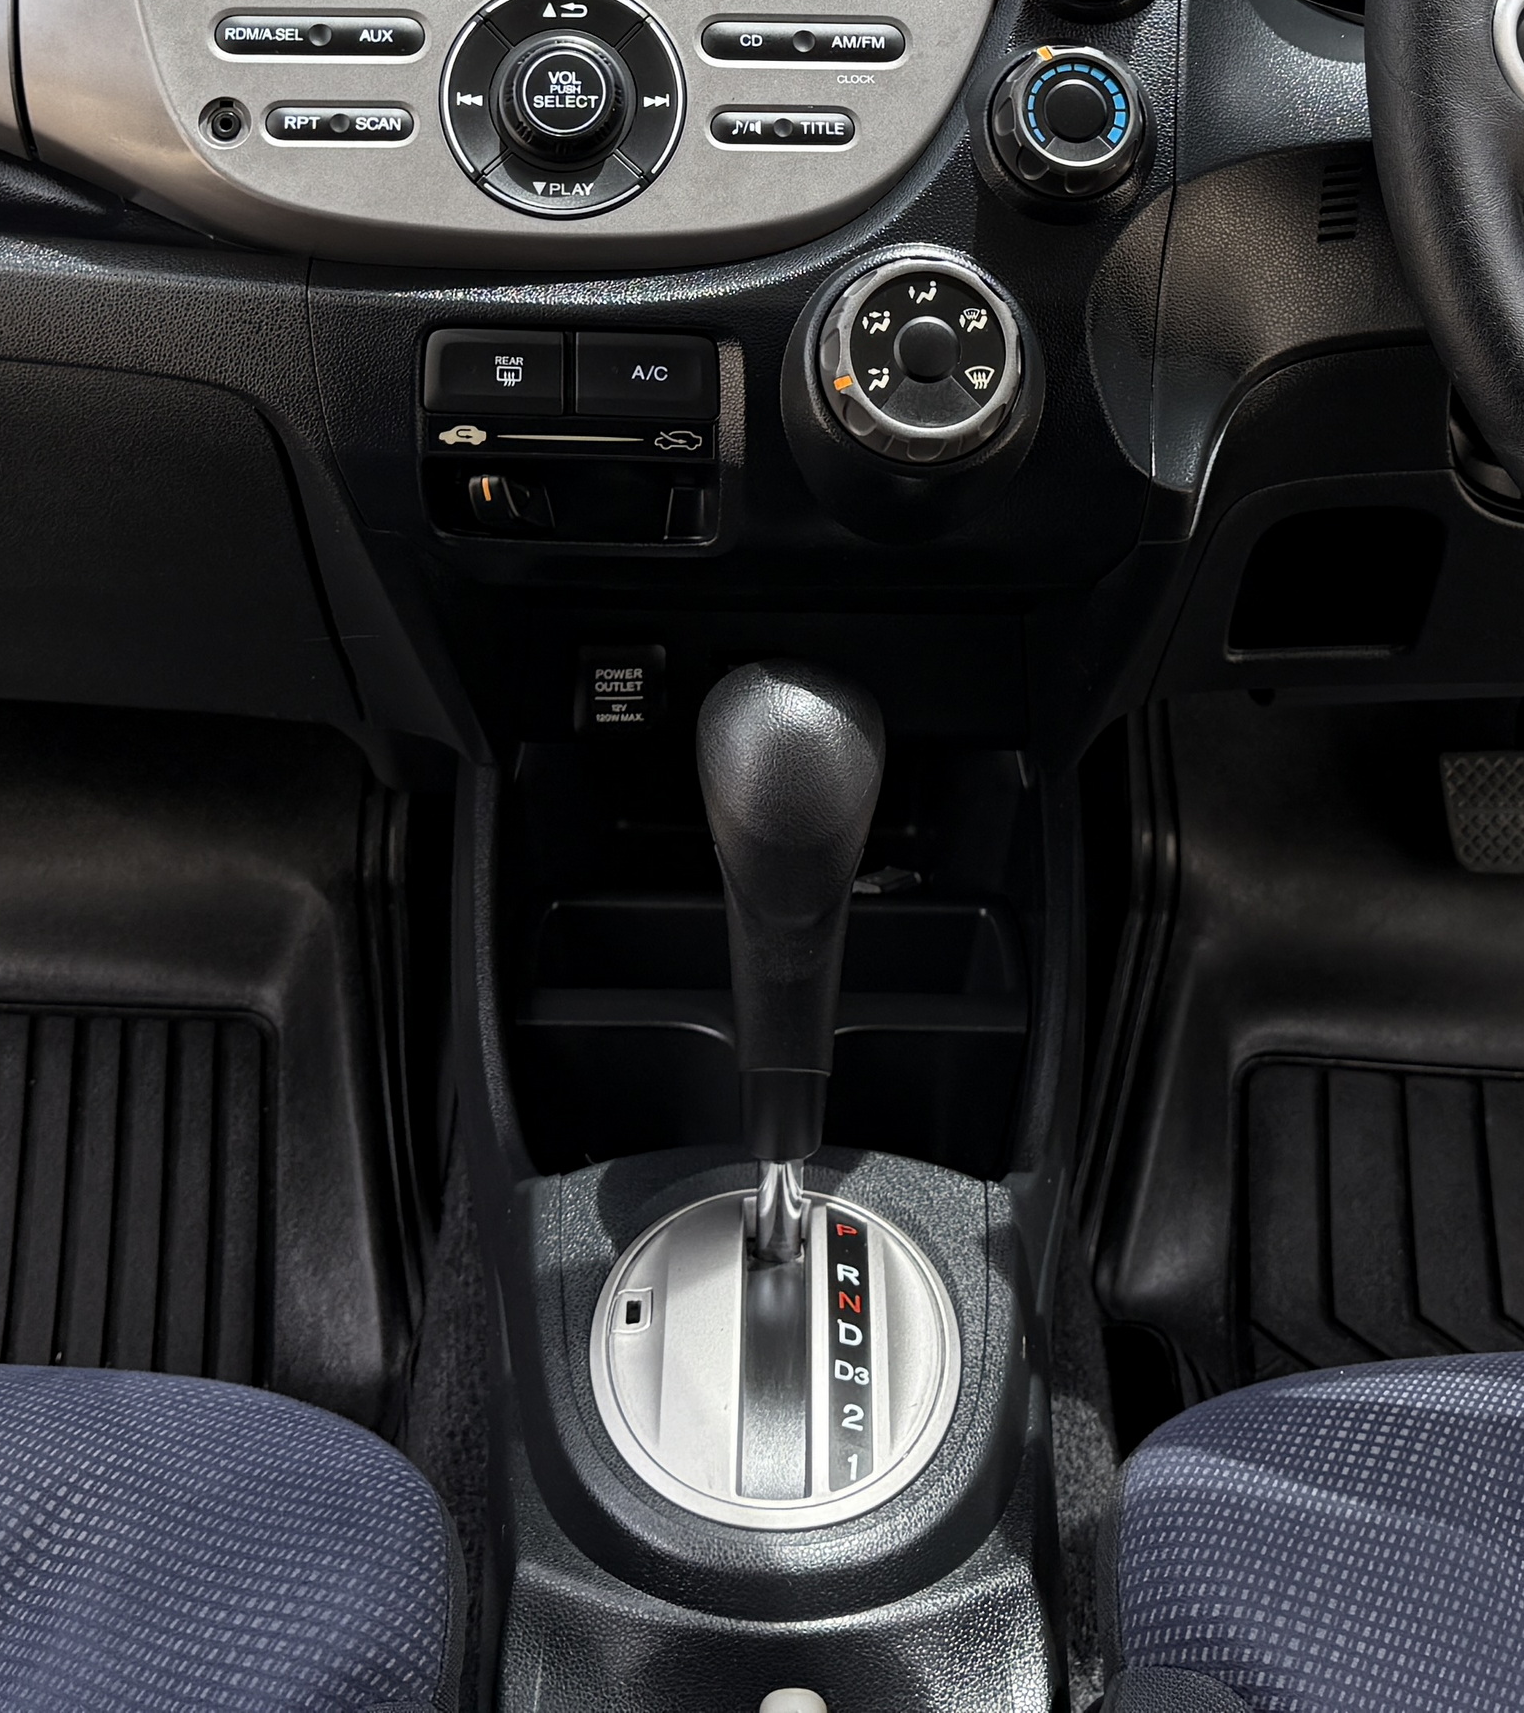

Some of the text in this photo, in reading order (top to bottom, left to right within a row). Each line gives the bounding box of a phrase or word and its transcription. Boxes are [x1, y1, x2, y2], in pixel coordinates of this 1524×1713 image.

[224, 27, 304, 42] RDM/A.SEL
[359, 28, 394, 43] AUX
[739, 34, 763, 49] CD
[831, 34, 886, 51] AM/FM
[548, 71, 582, 85] VOL
[837, 74, 876, 85] CLOCK
[549, 84, 582, 94] PUSH
[532, 94, 599, 109] SELECT
[284, 115, 321, 131] RPT
[355, 115, 402, 132] SCAN
[800, 121, 845, 136] TITLE
[549, 182, 595, 196] PLAY
[494, 355, 524, 366] REAR
[631, 365, 669, 382] A/C
[595, 668, 643, 680] POWER
[594, 681, 644, 692] OUTLET
[611, 703, 628, 712] 12V
[836, 1224, 857, 1236] P
[836, 1263, 860, 1286] R
[838, 1291, 862, 1313] N
[837, 1318, 863, 1347] D
[833, 1359, 870, 1386] D3
[841, 1403, 864, 1432] 2
[847, 1453, 858, 1481] 1
